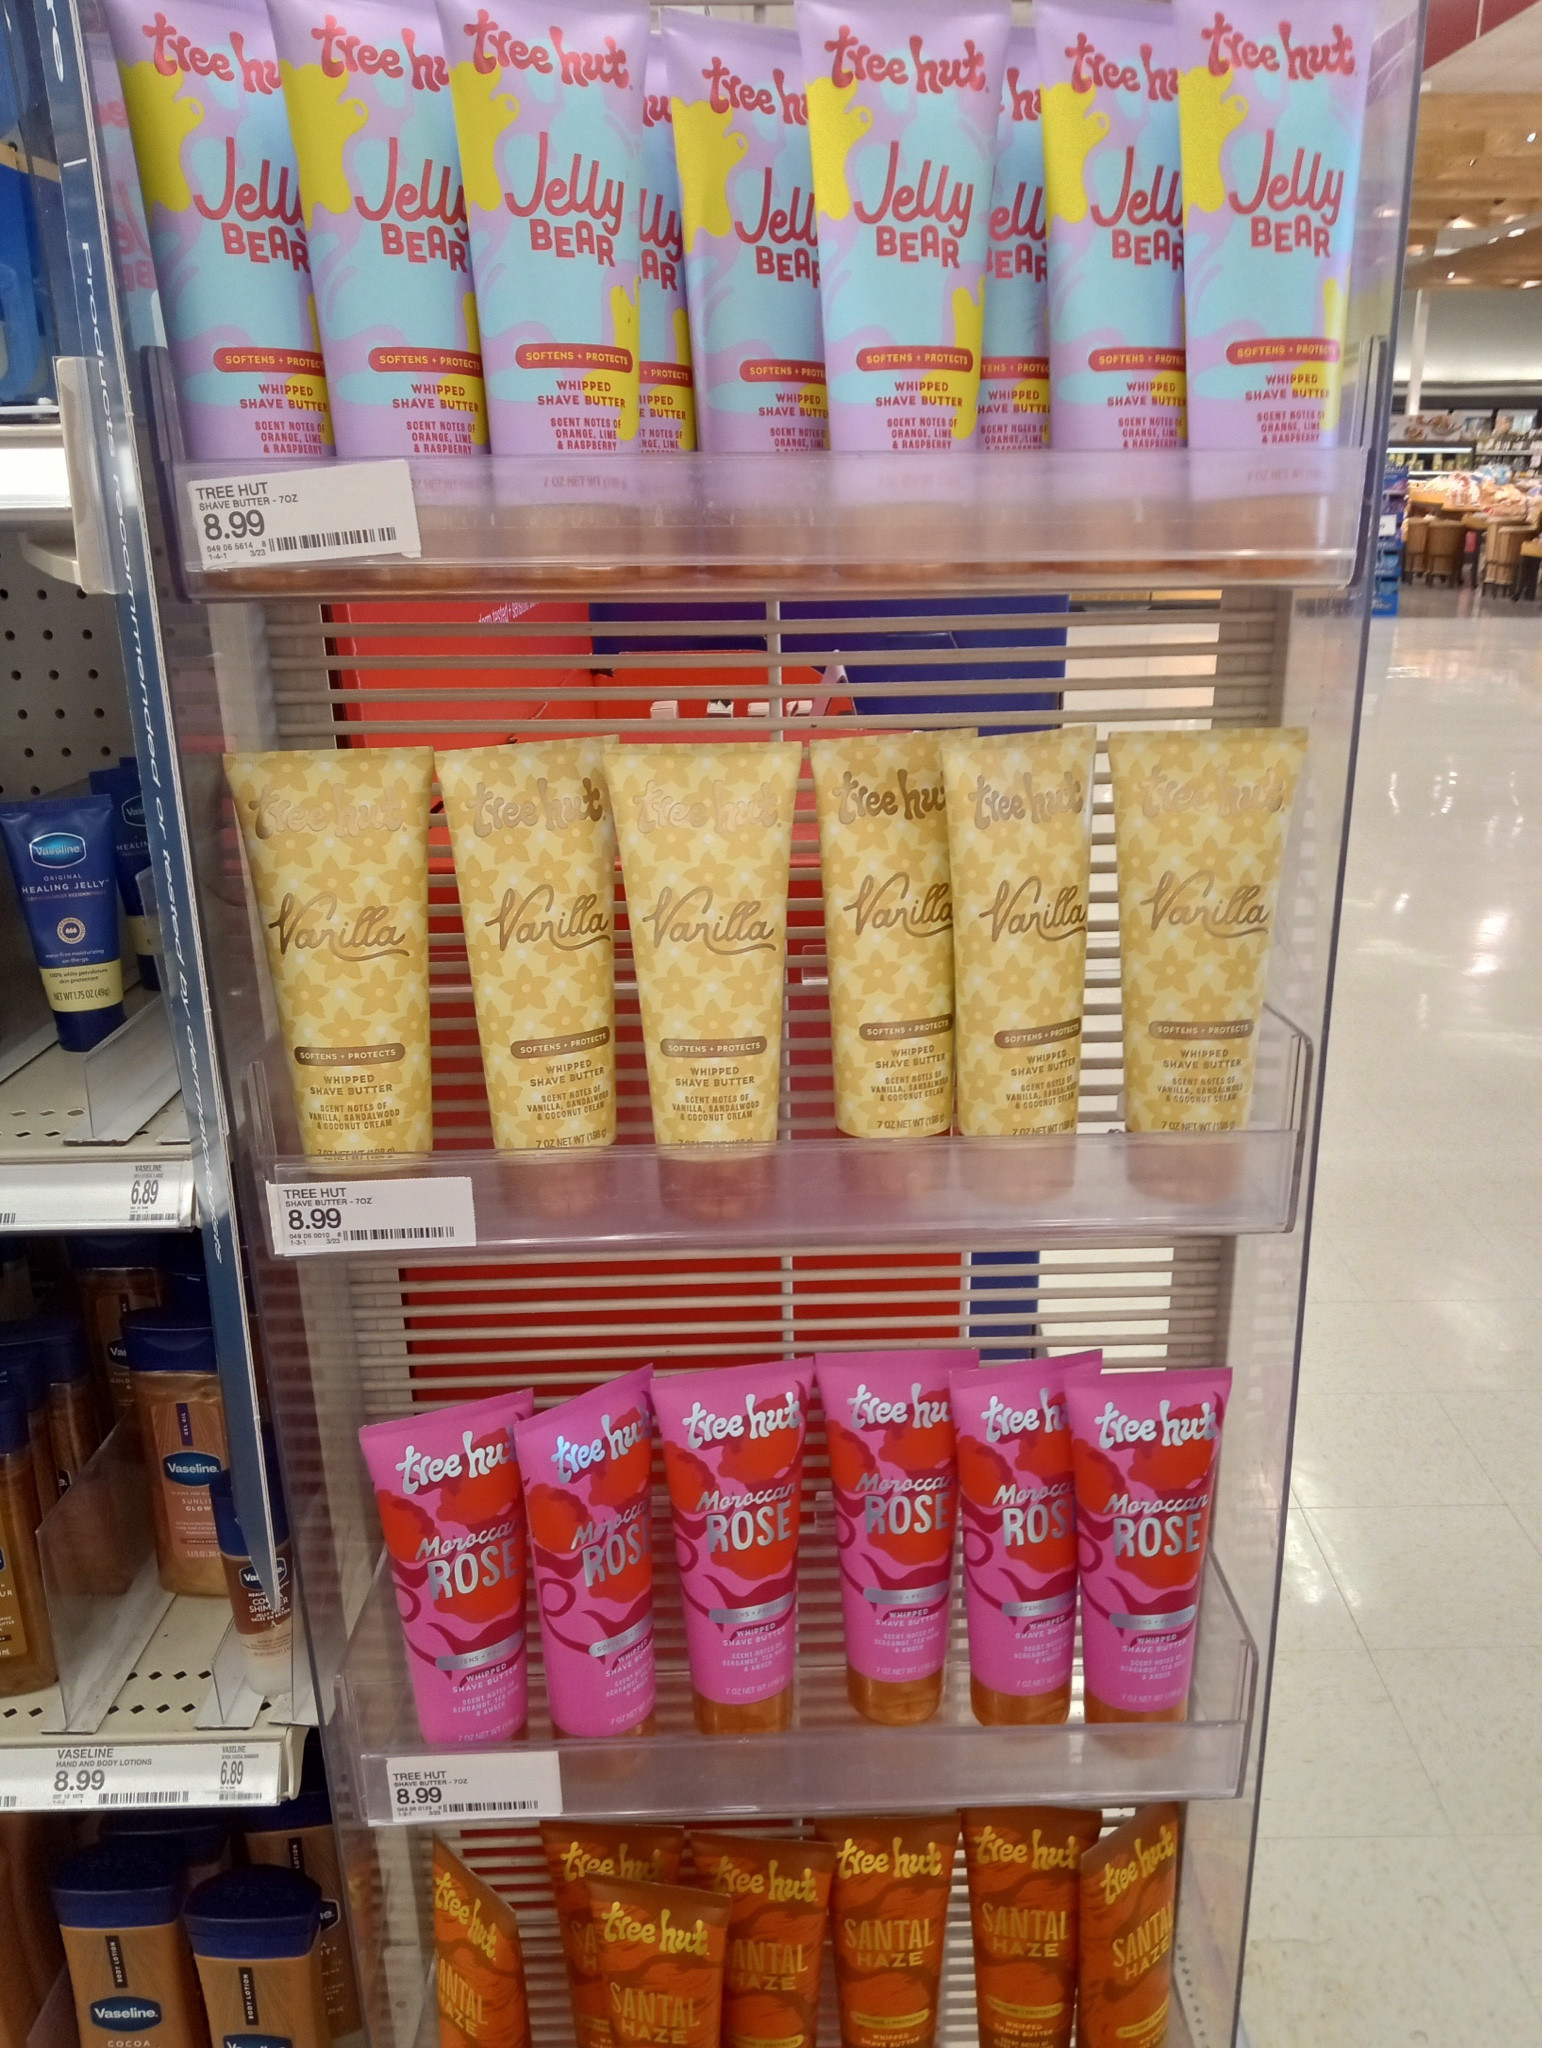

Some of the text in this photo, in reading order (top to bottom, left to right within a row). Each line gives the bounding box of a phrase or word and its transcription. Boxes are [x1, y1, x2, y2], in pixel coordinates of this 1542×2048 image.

[142, 12, 282, 95] tree hu
[311, 14, 450, 92] tree hu
[464, 9, 629, 89] tree hut
[824, 24, 986, 94] tree hut
[1201, 12, 1355, 80] tree hut
[1065, 32, 1141, 94] tree
[702, 57, 776, 114] tree
[505, 131, 624, 237] Jelly
[853, 140, 974, 238] Jelly
[1091, 146, 1183, 227] Jell
[1228, 128, 1344, 226] Jelly
[221, 222, 310, 273] BEAR
[380, 222, 467, 273] BEAR
[530, 219, 616, 268] BEAR
[876, 225, 960, 269] BEAR
[1250, 215, 1330, 258] BEAR
[380, 355, 481, 370] SOFTENS PROTECTS
[526, 352, 629, 366] SOFTENS PROTECTS
[866, 353, 968, 365] SOFTENS PROTECTS
[258, 384, 314, 397] WHIPPED
[411, 384, 466, 397] WHIPPED
[556, 380, 611, 392] WHIPPED
[894, 381, 949, 392] WHIPPED
[240, 398, 328, 412] SHAVE BUTTER
[392, 398, 479, 413] SHAVE BUTTER
[538, 395, 626, 408] SHAVE BUTTER
[876, 396, 963, 408] SHAVE BUTTER
[551, 417, 621, 429] SCENT NOTES OF
[600, 430, 617, 440] LIME
[557, 440, 617, 451] & RASPBERRY
[196, 482, 268, 500] TREE HUT
[199, 494, 298, 511] SHAVE BUTTER 7OZ
[203, 509, 265, 541] 8.99
[234, 542, 253, 550] 5614
[467, 776, 604, 838] tree hut
[832, 771, 898, 825] tree
[968, 771, 1084, 830] tree hut
[34, 844, 80, 856] Vaseline
[43, 873, 82, 882] ORIGINAL
[113, 474, 161, 788] recommended
[155, 796, 167, 840] or
[162, 849, 186, 966] tested
[179, 970, 191, 1018] by
[187, 1025, 223, 1264] dermatologists
[22, 880, 105, 894] HEALING JELLY
[485, 884, 611, 951] Vanilla
[979, 875, 1087, 942] Vanilla
[1140, 870, 1269, 938] Vanilla
[268, 892, 410, 962] Vanilla
[642, 886, 777, 956] Vanilla
[668, 1041, 761, 1053] SOFTENS PROTECTS
[675, 1075, 754, 1087] SHAVE BUTTER
[690, 1066, 740, 1076] WHIPPED
[135, 1164, 162, 1172] VASELINE
[131, 1180, 159, 1205] 6.89
[283, 1187, 347, 1199] TREE HUT
[285, 1200, 313, 1208] SHAVE
[314, 1199, 348, 1207] BUTTER
[288, 1208, 342, 1231] 8.99
[682, 1391, 800, 1450] tree hut
[847, 1383, 950, 1430] tree hu
[1094, 1400, 1218, 1450] tree hut
[395, 1445, 462, 1495] tree
[185, 1504, 211, 1512] GLOW
[695, 1482, 797, 1512] Moroccan
[1103, 1493, 1208, 1515] Moroccan
[706, 1500, 792, 1553] ROSE
[864, 1491, 950, 1535] ROSE
[1113, 1513, 1201, 1558] ROSE
[427, 1537, 517, 1600] ROSE
[736, 1622, 776, 1638] WHIPPED
[56, 1760, 78, 1768] HAND
[97, 1759, 118, 1767] BODY
[119, 1758, 153, 1766] LOTIONS
[57, 1748, 114, 1759] VASELINE
[222, 1745, 247, 1754] VASELINE
[54, 1769, 106, 1792] 8.99
[220, 1760, 244, 1786] 6.89
[393, 1771, 447, 1781] TREE HUT
[396, 1786, 442, 1805] 8.99
[837, 1837, 942, 1880] tree hut
[974, 1825, 1079, 1870] tree hut
[1102, 1825, 1175, 1905] tree hut
[435, 1872, 497, 1958] tree hut
[602, 1901, 710, 1956] tree hut
[844, 1918, 935, 1951] SANTAL
[857, 1951, 924, 1968] HAZE
[610, 1982, 700, 2028] SANTAL
[107, 2040, 151, 2048] COCOA
[621, 2019, 688, 2045] HAZE
